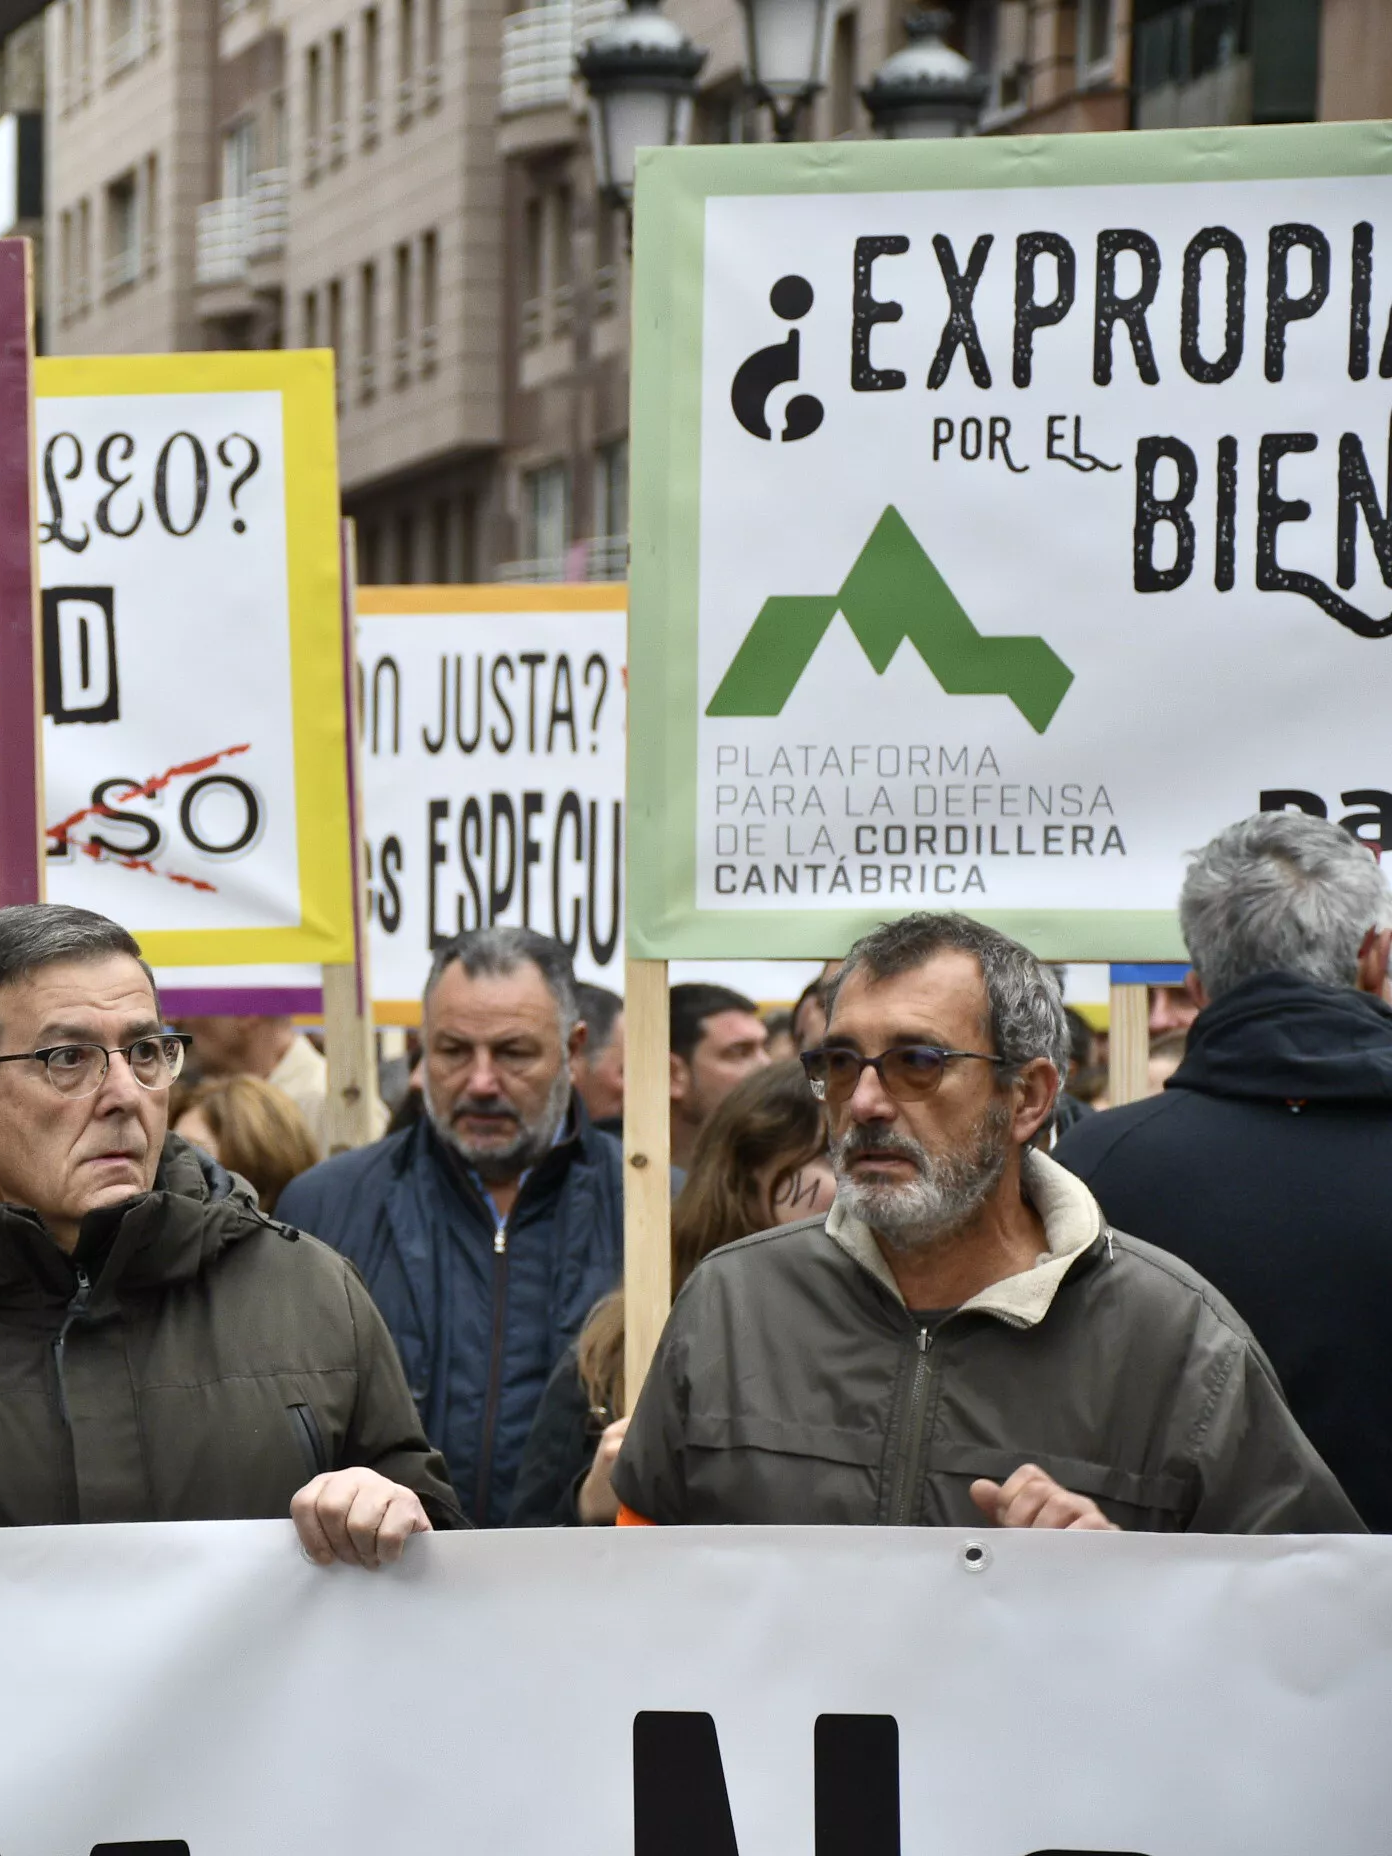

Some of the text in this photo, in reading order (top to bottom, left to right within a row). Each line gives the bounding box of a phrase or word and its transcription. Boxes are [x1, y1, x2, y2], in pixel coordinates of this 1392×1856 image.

[730, 221, 1392, 442] ¿EXPROPI
[933, 414, 1122, 473] POR EL
[421, 652, 607, 755] JUSTA?
[715, 744, 1002, 778] PLATAFORMA
[715, 782, 1115, 818] PARA LA DEFENSA
[715, 822, 1127, 857] DE LA CORDILLERA
[714, 854, 987, 896] CANTÁBRICA
